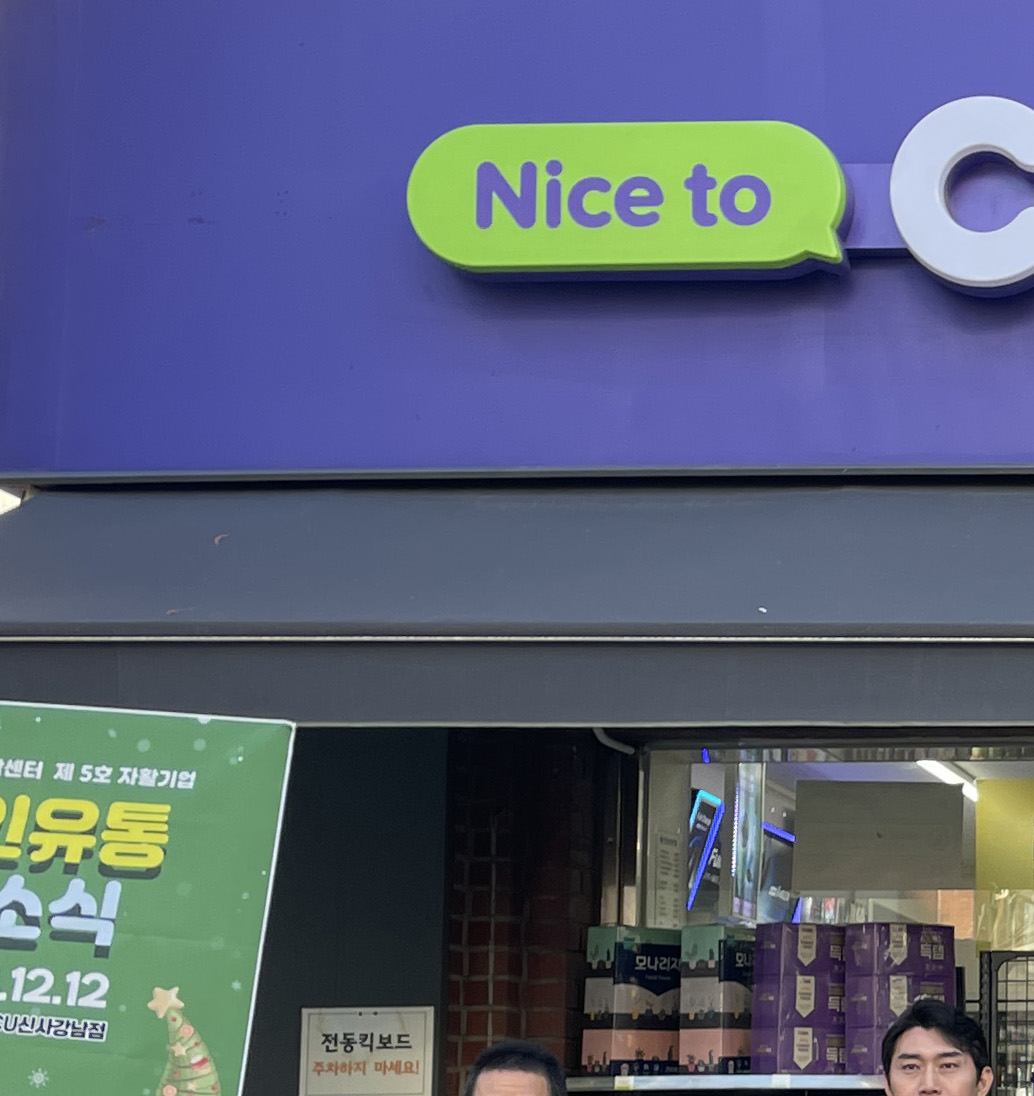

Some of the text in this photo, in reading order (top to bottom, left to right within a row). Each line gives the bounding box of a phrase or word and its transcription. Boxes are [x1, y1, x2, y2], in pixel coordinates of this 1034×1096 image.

[475, 158, 773, 230] Nice to
[0, 758, 197, 789] 센터 제 5호 자활기업
[0, 1014, 106, 1040] U신사강남점
[321, 1032, 412, 1053] 전동킥보드
[312, 1060, 419, 1076] 주차하지 마세요!
